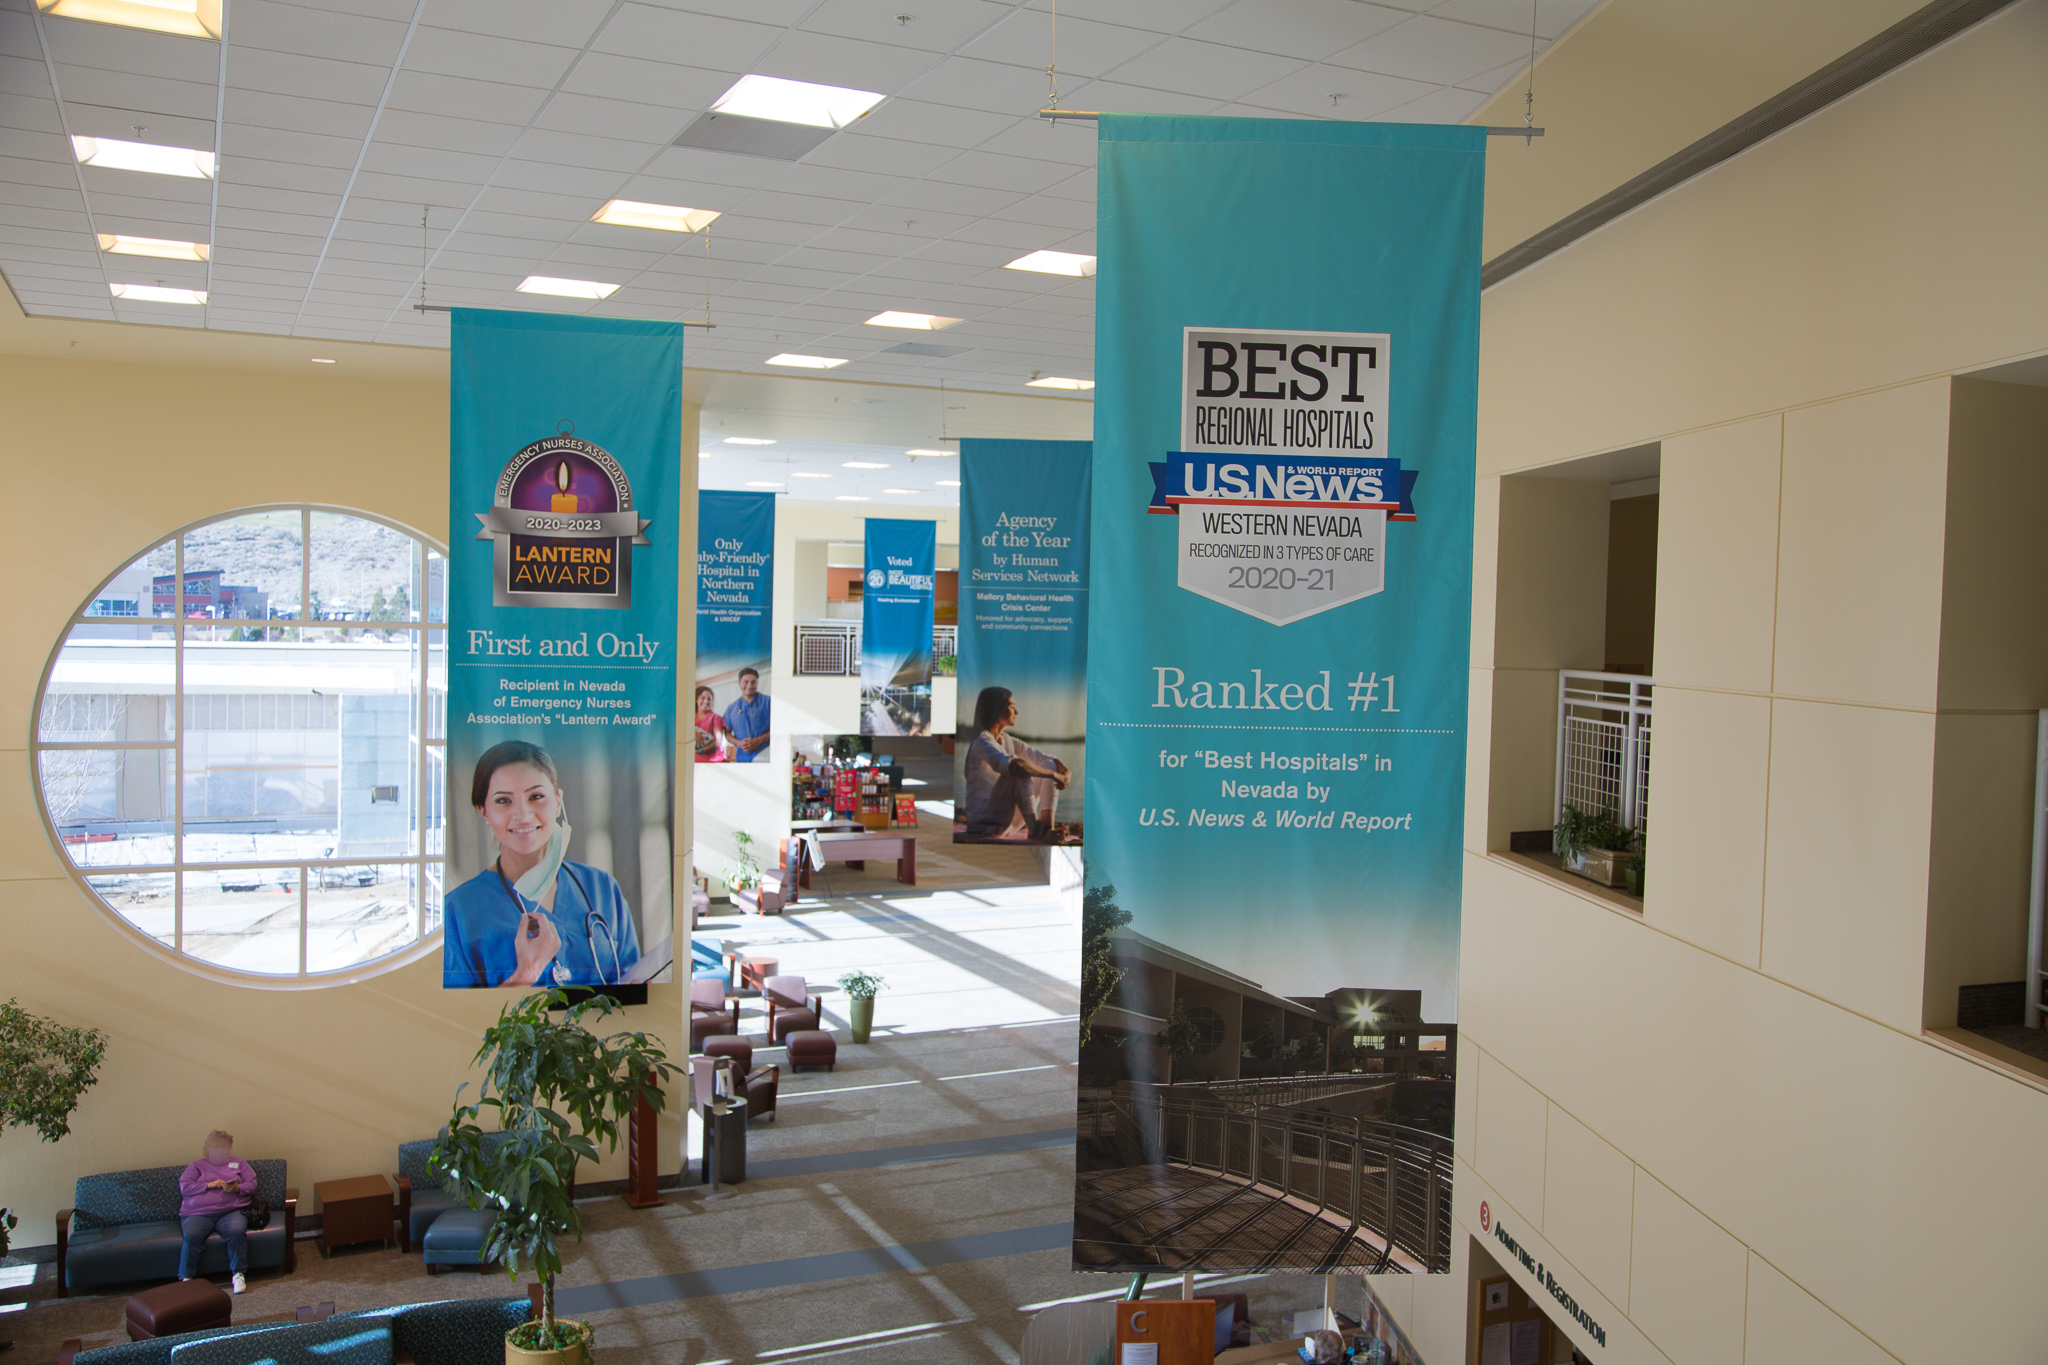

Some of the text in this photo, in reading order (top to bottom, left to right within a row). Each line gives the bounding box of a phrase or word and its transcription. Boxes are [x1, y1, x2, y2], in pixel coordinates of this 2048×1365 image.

[1196, 340, 1376, 403] BEST
[1196, 406, 1373, 450] REGIONAL HOSPITALS
[499, 439, 629, 501] EMERGENCY NURSES ASSOCIATION
[1297, 467, 1336, 475] WORLD
[1339, 468, 1383, 476] REPORT
[996, 511, 1057, 531] Agency
[1202, 512, 1362, 537] WESTERN NEVADA
[715, 538, 743, 551] Only
[982, 531, 1071, 547] of the Year
[516, 546, 611, 563] LANTERN
[887, 556, 912, 566] Voted
[993, 553, 1058, 567] by Human
[1190, 543, 1374, 562] RECOGNIZED IN 3 TYPES OF CARE
[515, 565, 609, 584] AWARD
[697, 564, 759, 578] Hospital in
[972, 569, 1079, 582] Services Network
[1228, 566, 1334, 591] 2020-21
[702, 577, 754, 589] Northern
[869, 576, 883, 586] 20
[889, 575, 932, 585] BEAUTIFUL
[707, 591, 749, 603] Nevada
[977, 593, 1004, 601] Mallory
[1001, 603, 1051, 612] Crisis Center
[467, 630, 659, 662] First and Only
[500, 679, 625, 694] Recipient in Nevada
[1151, 667, 1400, 712] Ranked #1
[494, 697, 631, 710] of Emergency Nurses
[1159, 750, 1187, 768] for
[1374, 754, 1392, 772] in
[1222, 781, 1330, 803] Nevada by
[1139, 809, 1412, 833] U.S. News & World Report
[1482, 1206, 1488, 1226] 3
[1537, 1263, 1544, 1285] &
